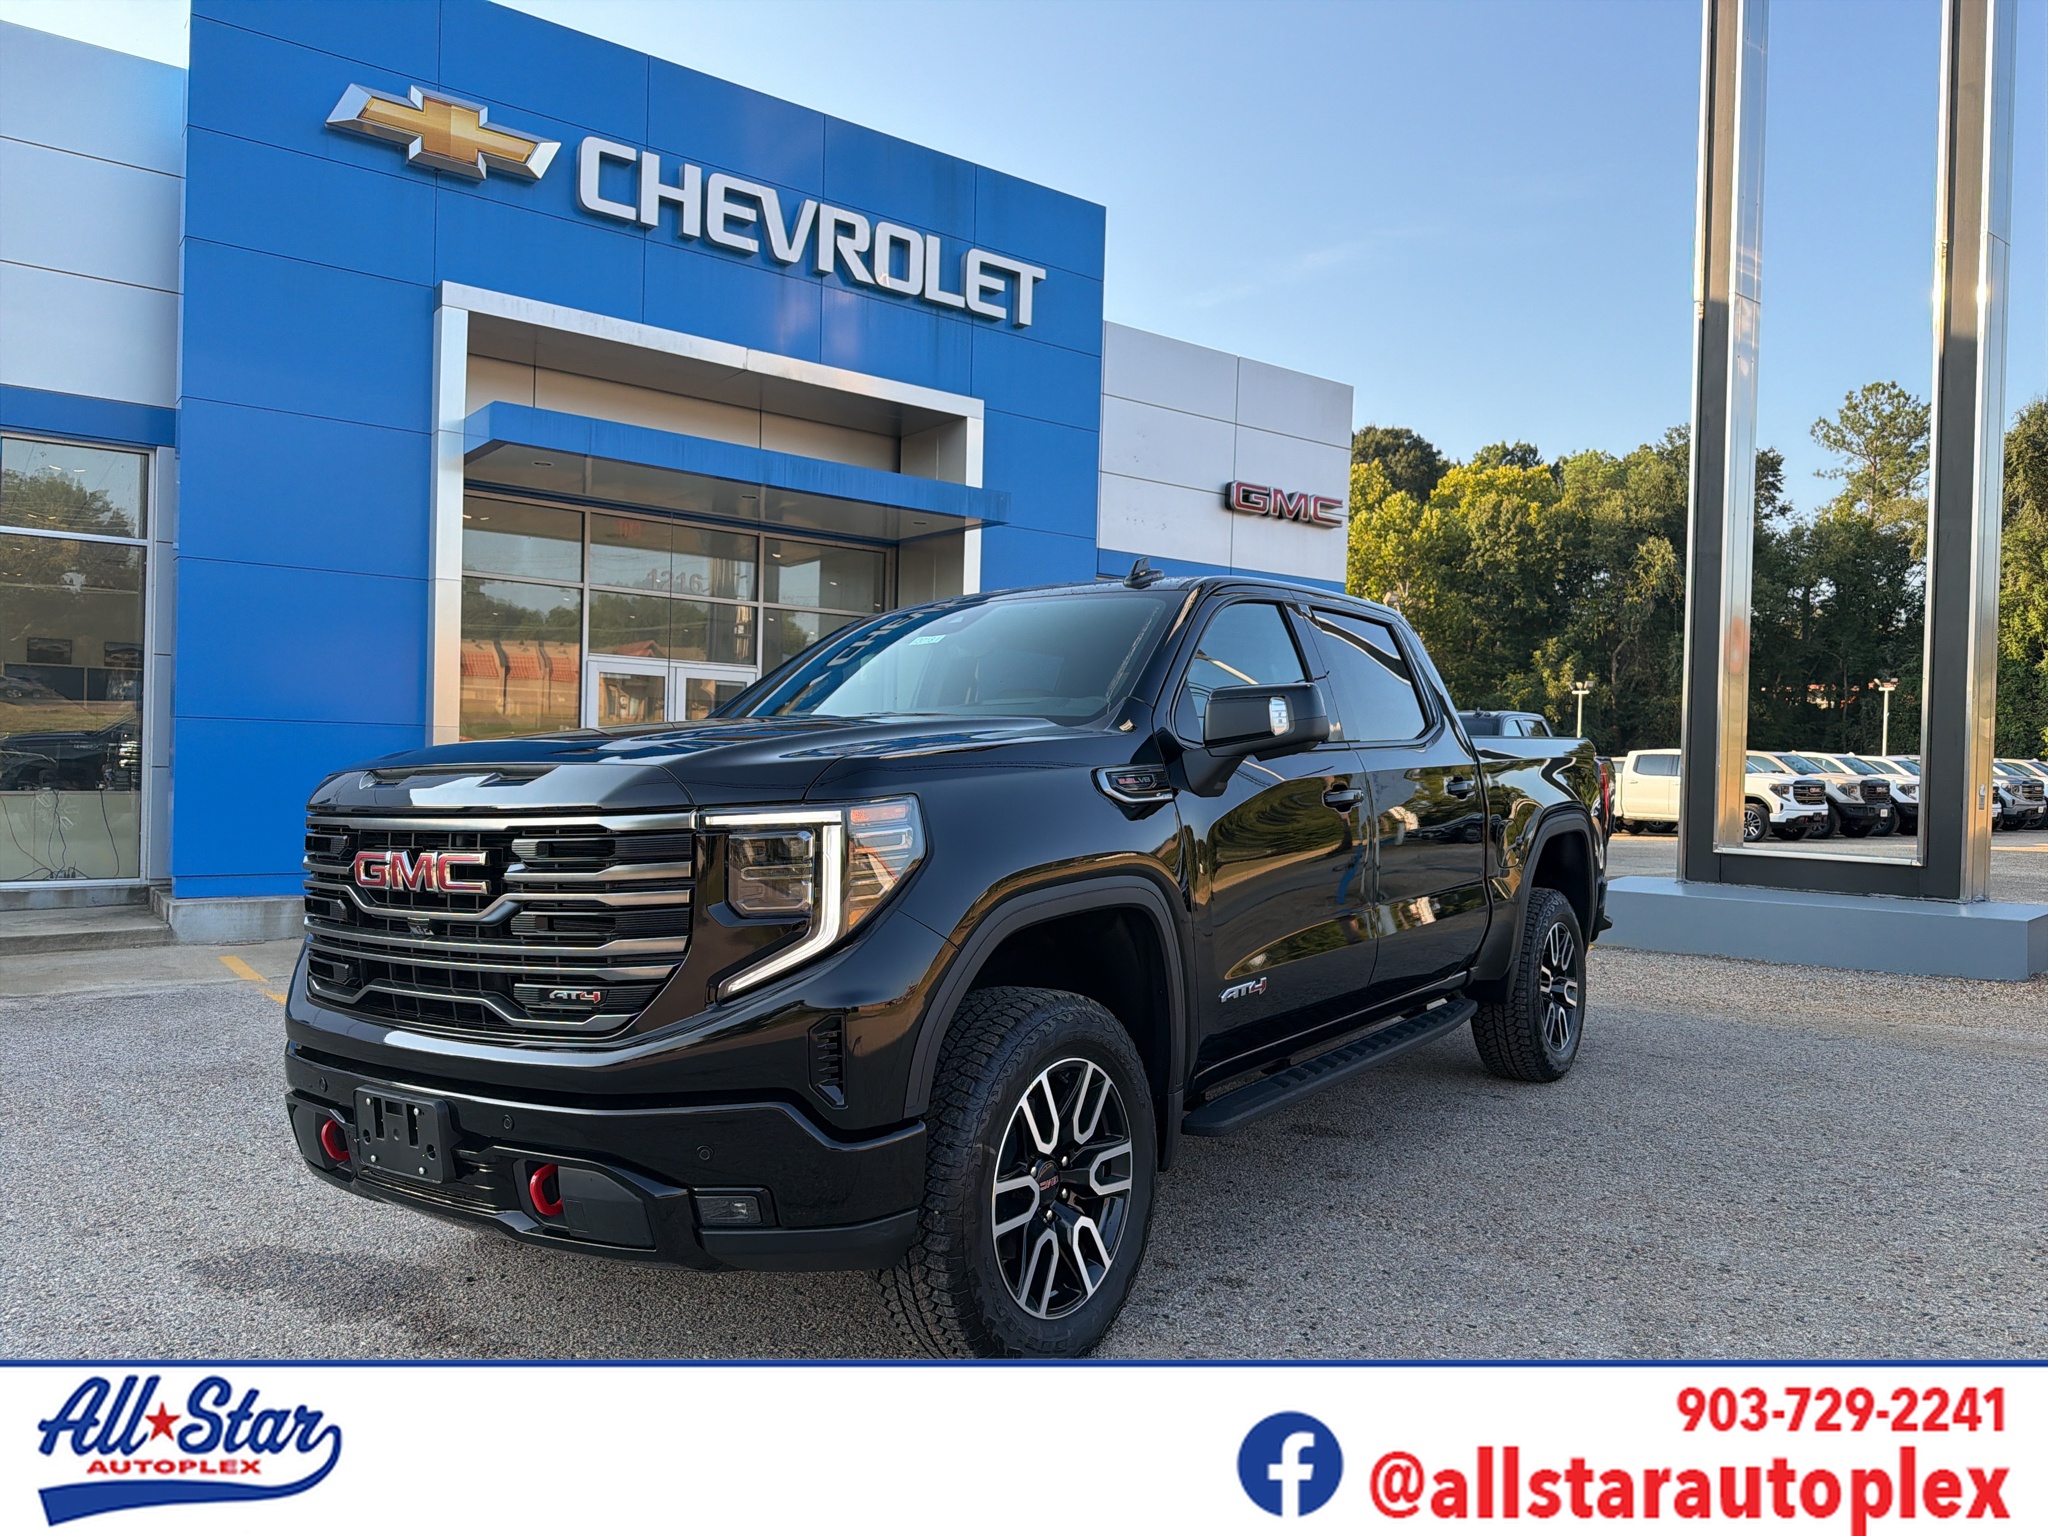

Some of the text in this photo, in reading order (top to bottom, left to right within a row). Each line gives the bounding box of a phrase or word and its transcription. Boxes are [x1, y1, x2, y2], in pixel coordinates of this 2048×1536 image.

[577, 136, 1047, 328] CHEVROLET
[1226, 480, 1343, 528] GMC
[647, 569, 704, 593] 1216
[355, 850, 488, 894] GMC
[549, 989, 601, 1004] AT4
[1220, 976, 1267, 1003] AT4
